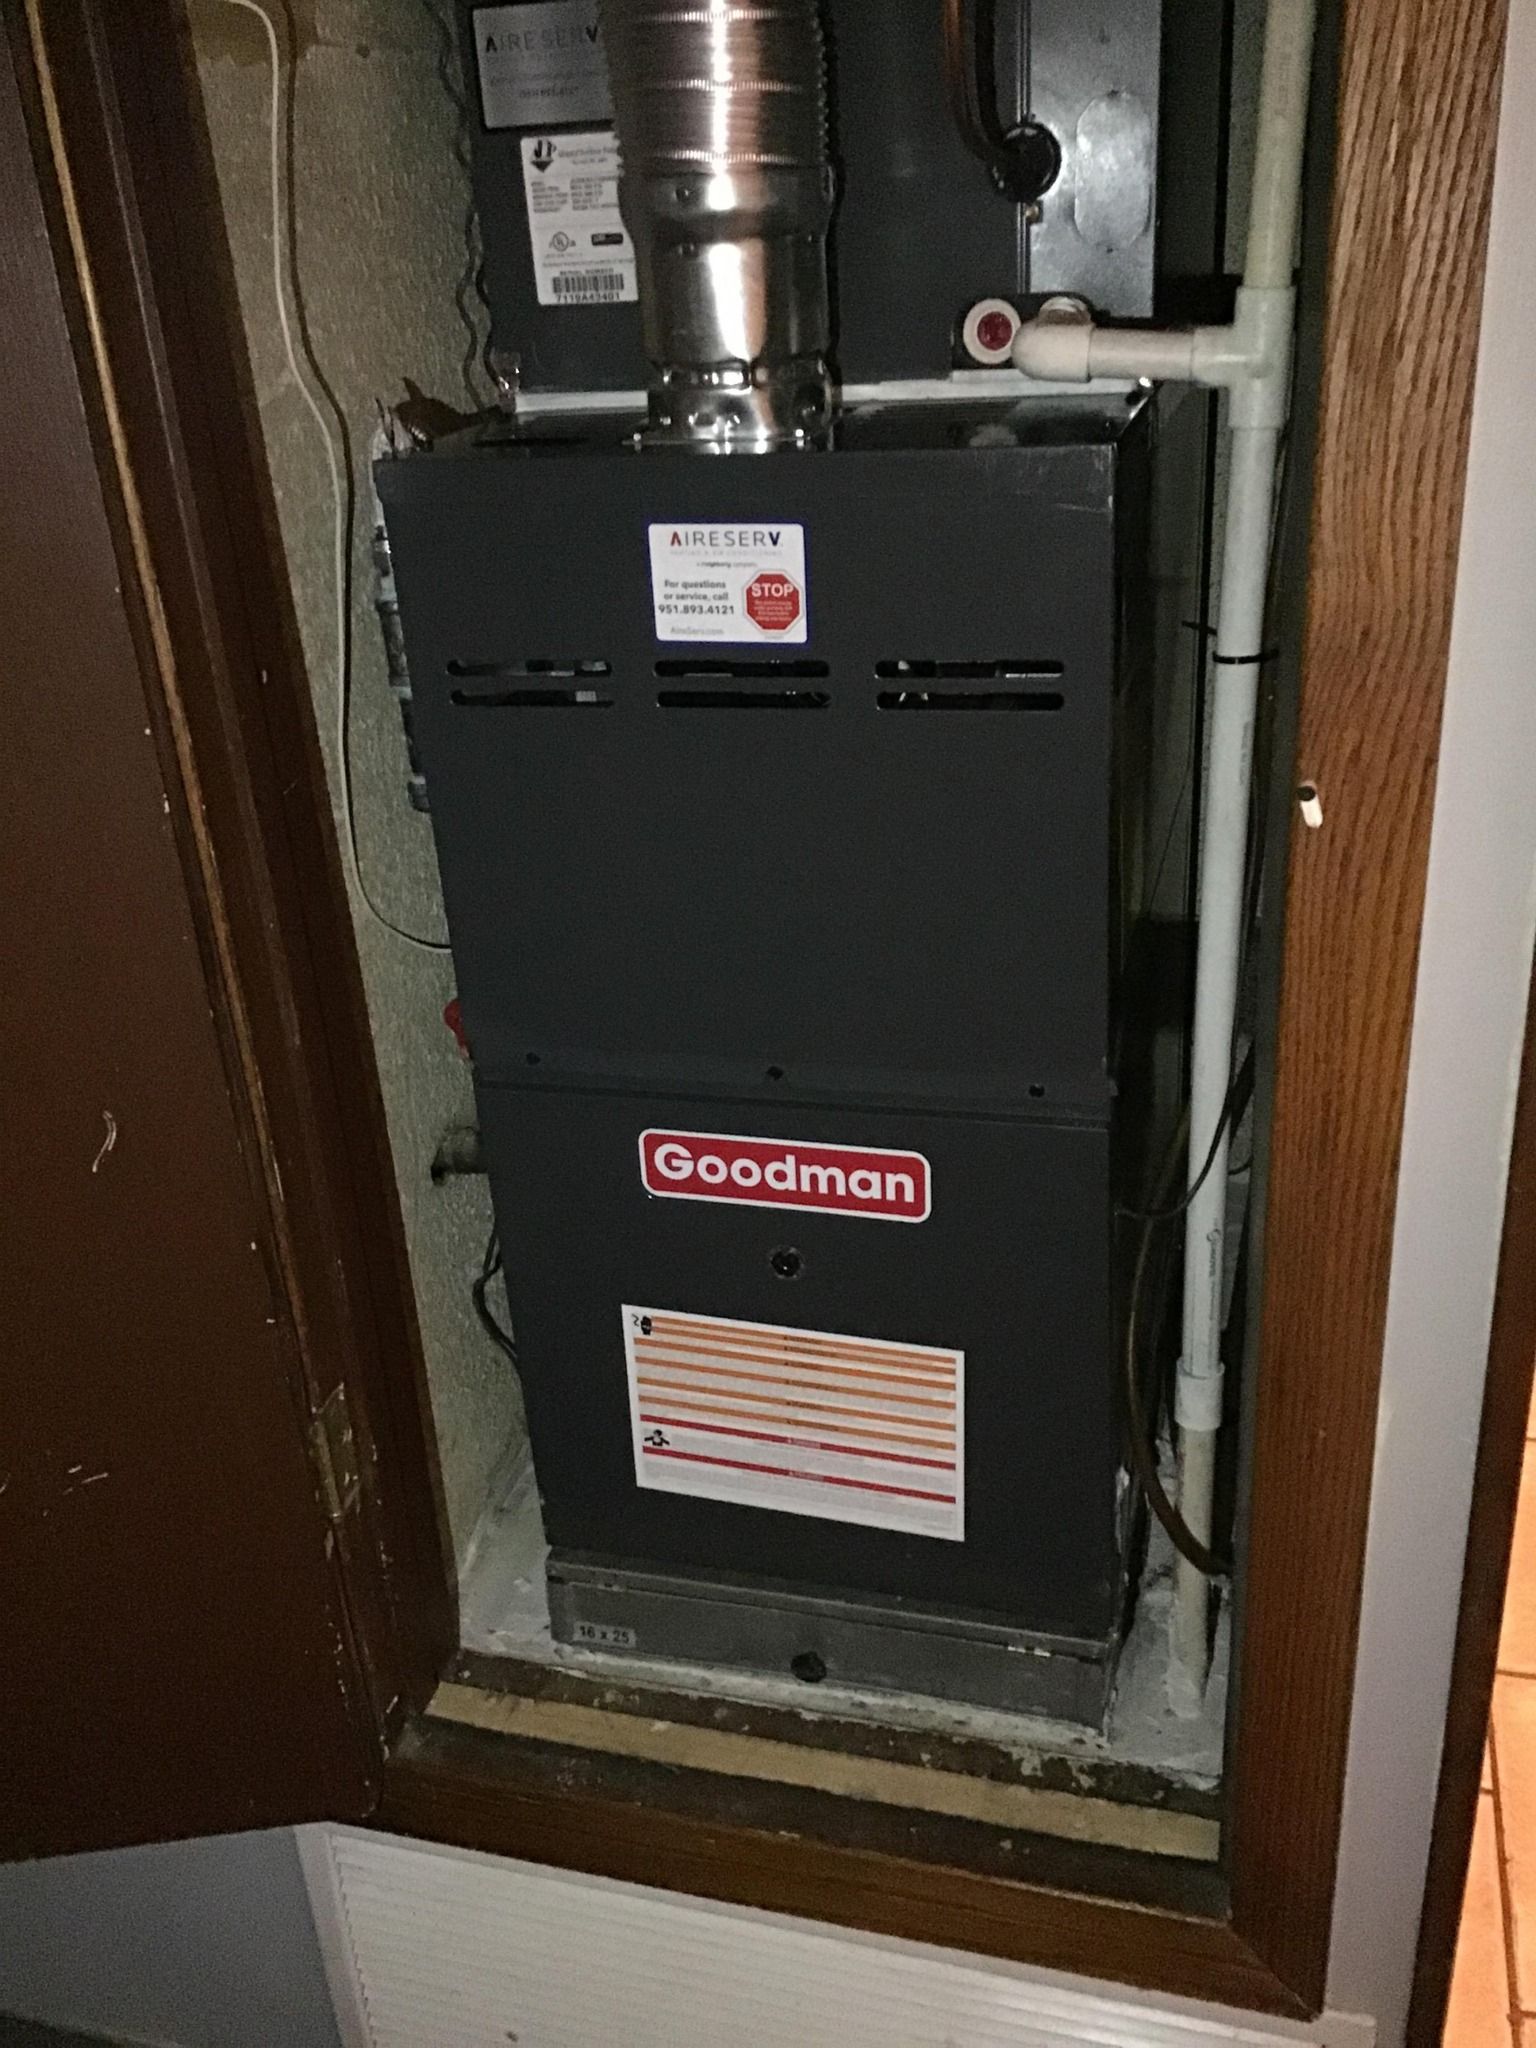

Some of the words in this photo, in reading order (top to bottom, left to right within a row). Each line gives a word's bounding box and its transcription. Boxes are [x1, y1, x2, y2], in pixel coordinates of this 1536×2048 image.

[670, 531, 781, 547] AIRESERV
[664, 579, 679, 588] For
[681, 579, 726, 591] questions
[751, 582, 794, 597] STOP
[712, 592, 729, 600] call
[658, 604, 734, 615] 951.893.4121
[654, 1143, 915, 1203] Goodman
[579, 1625, 596, 1639] 16
[613, 1630, 630, 1644] 25
